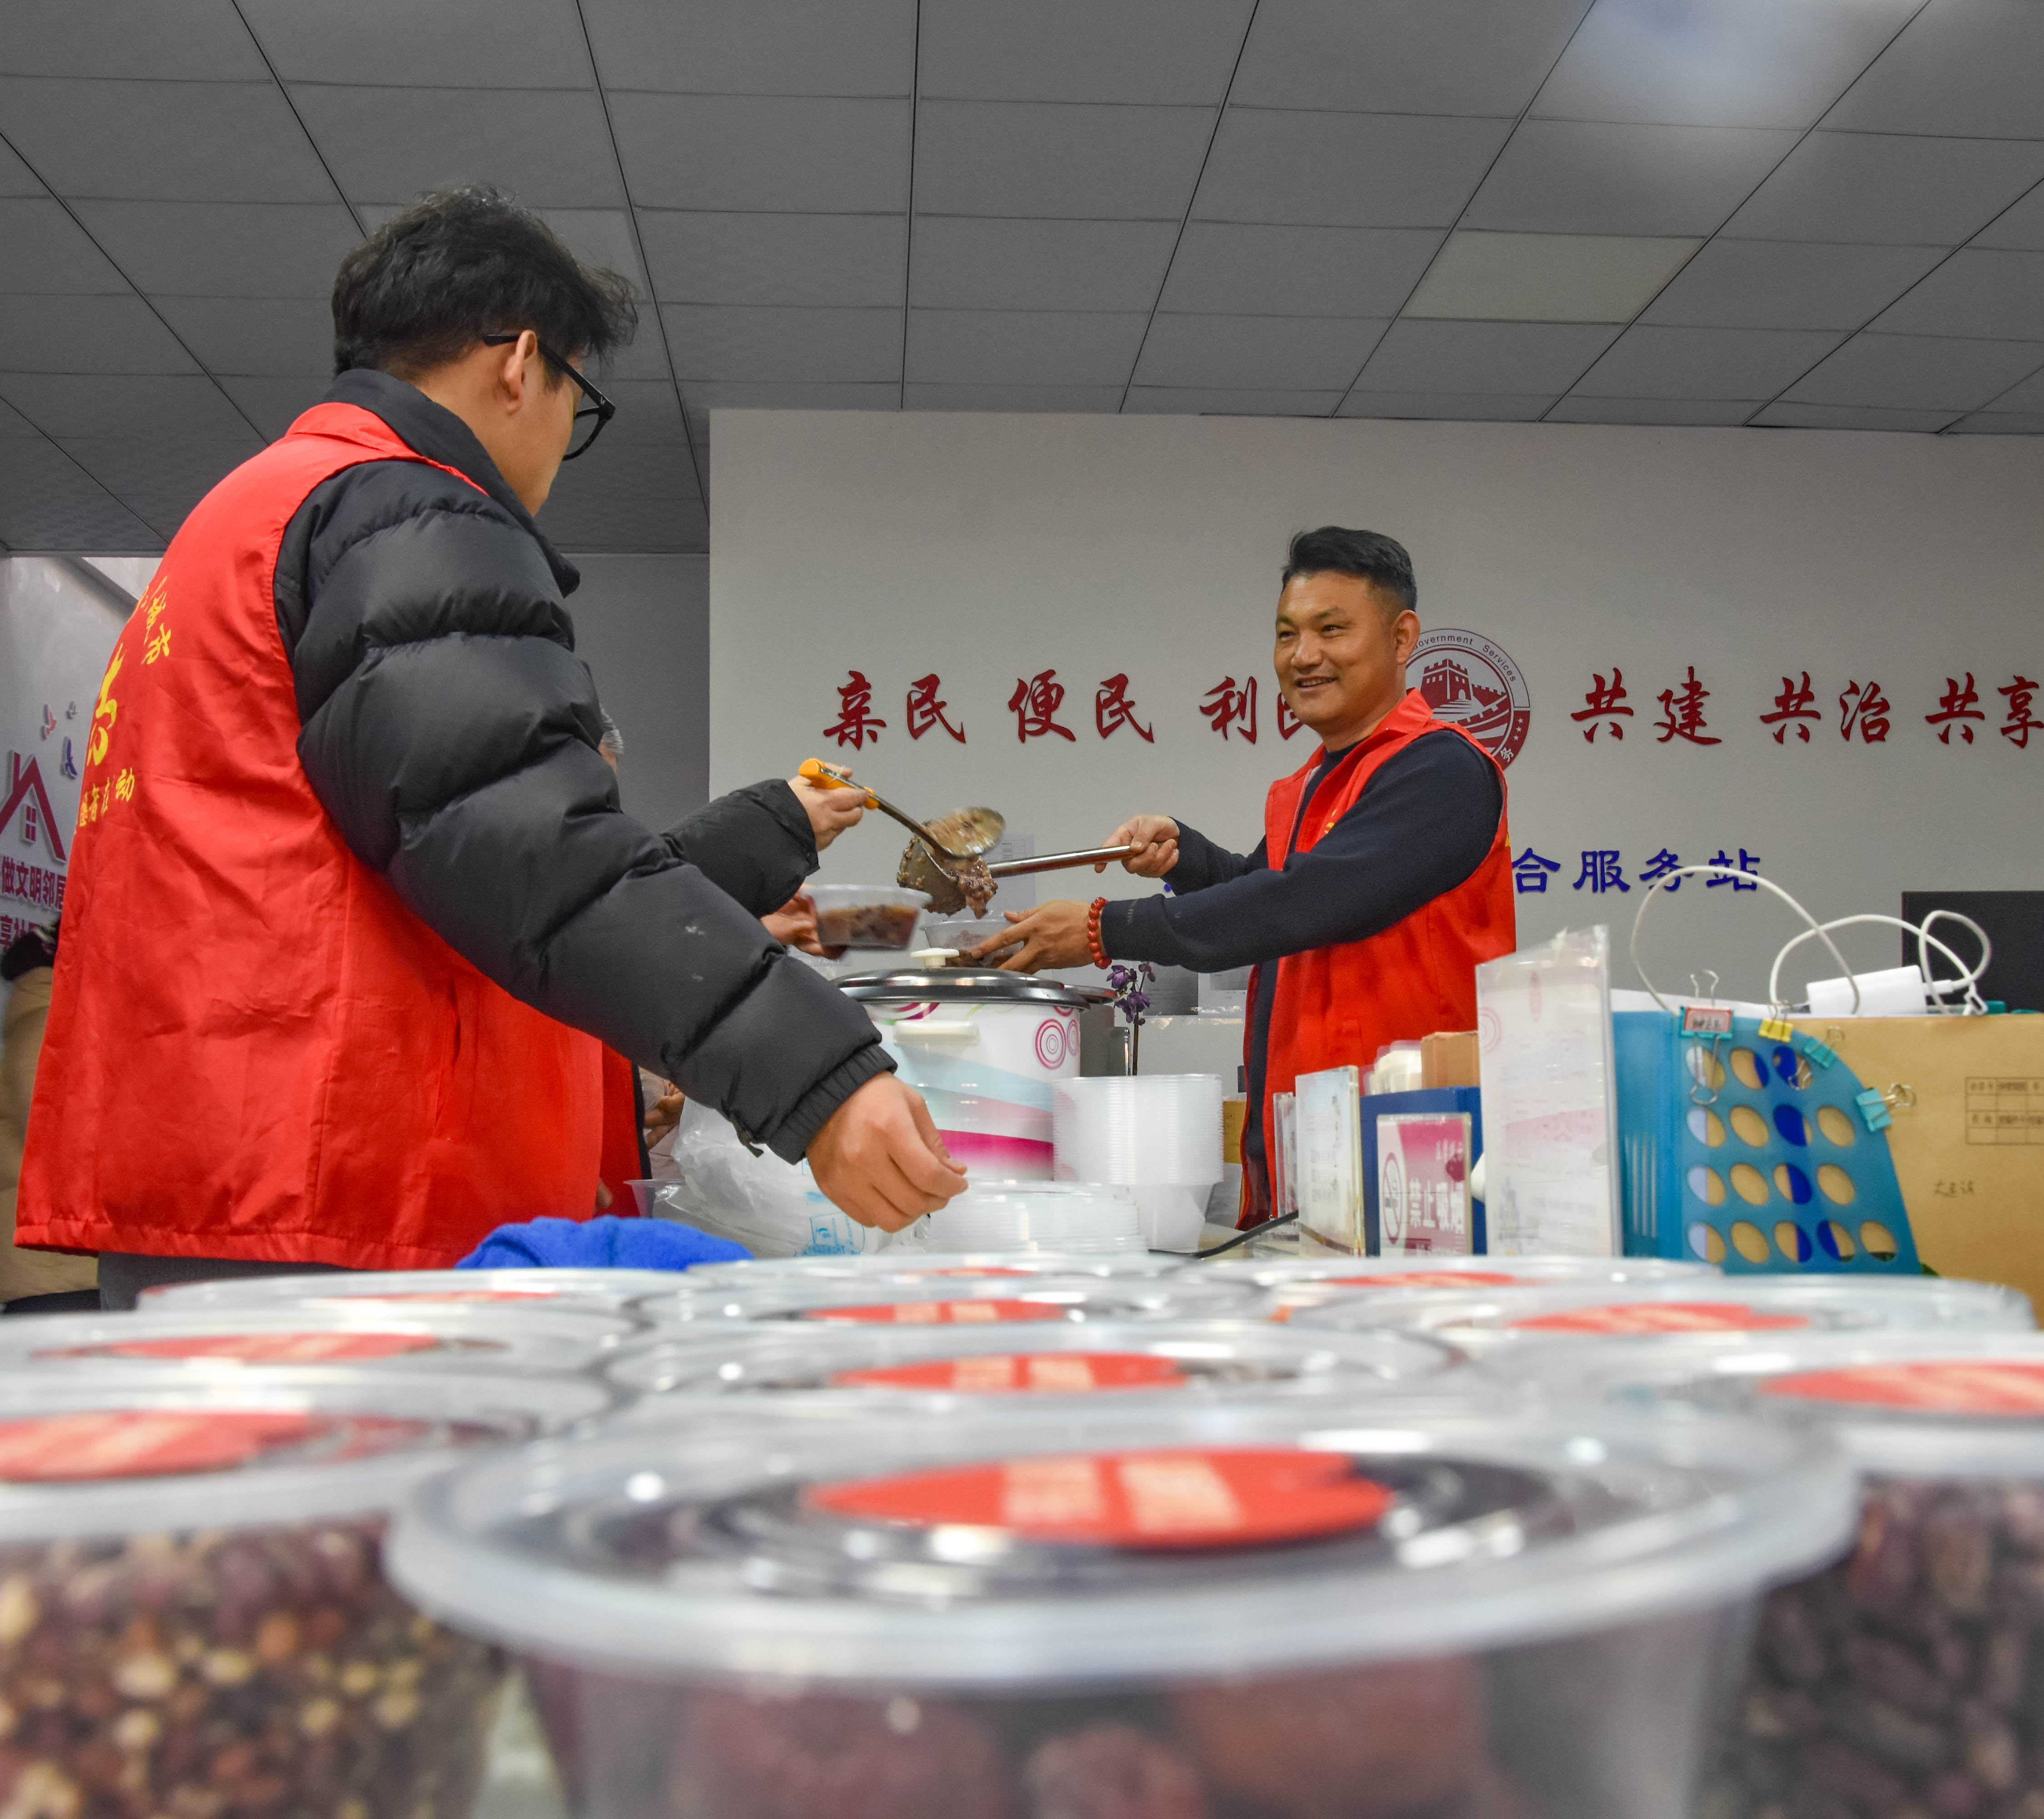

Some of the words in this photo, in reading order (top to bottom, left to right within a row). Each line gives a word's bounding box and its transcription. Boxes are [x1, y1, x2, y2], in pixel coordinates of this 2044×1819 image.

[1415, 635, 1473, 649] overnment
[1482, 644, 1516, 682] Services
[823, 670, 966, 750] 亲民
[1007, 669, 1155, 743] 便民
[1571, 666, 1722, 746] 共建
[1759, 672, 1891, 744] 共治
[1925, 672, 2044, 749] 共享
[1512, 847, 1761, 894] 合服务站
